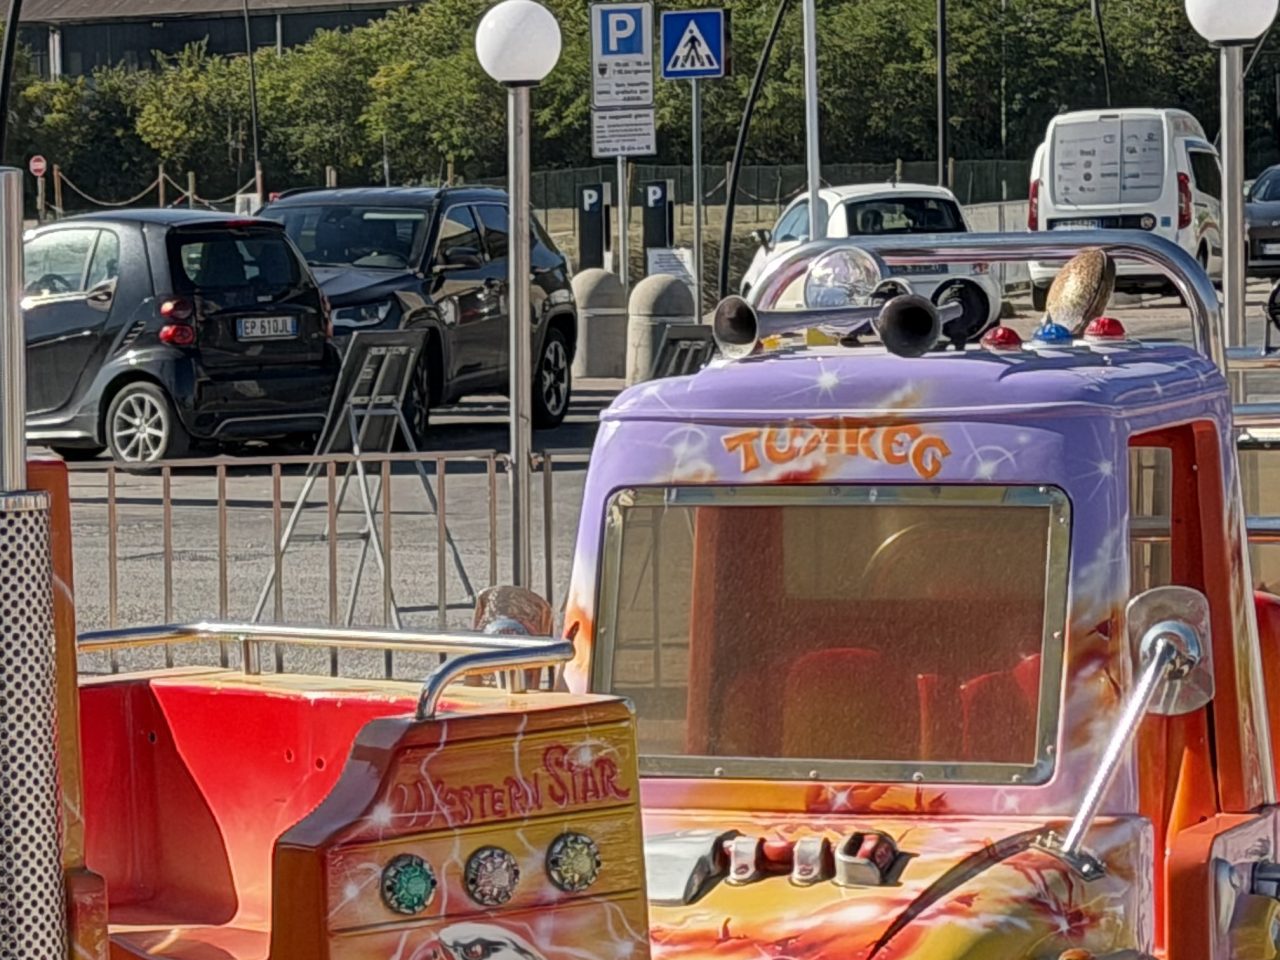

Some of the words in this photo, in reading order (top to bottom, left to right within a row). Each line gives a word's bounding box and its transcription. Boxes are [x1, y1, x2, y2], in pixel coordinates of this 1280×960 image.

[609, 13, 636, 51] P
[583, 189, 599, 212] P
[648, 185, 662, 208] P
[543, 744, 631, 809] STAR
